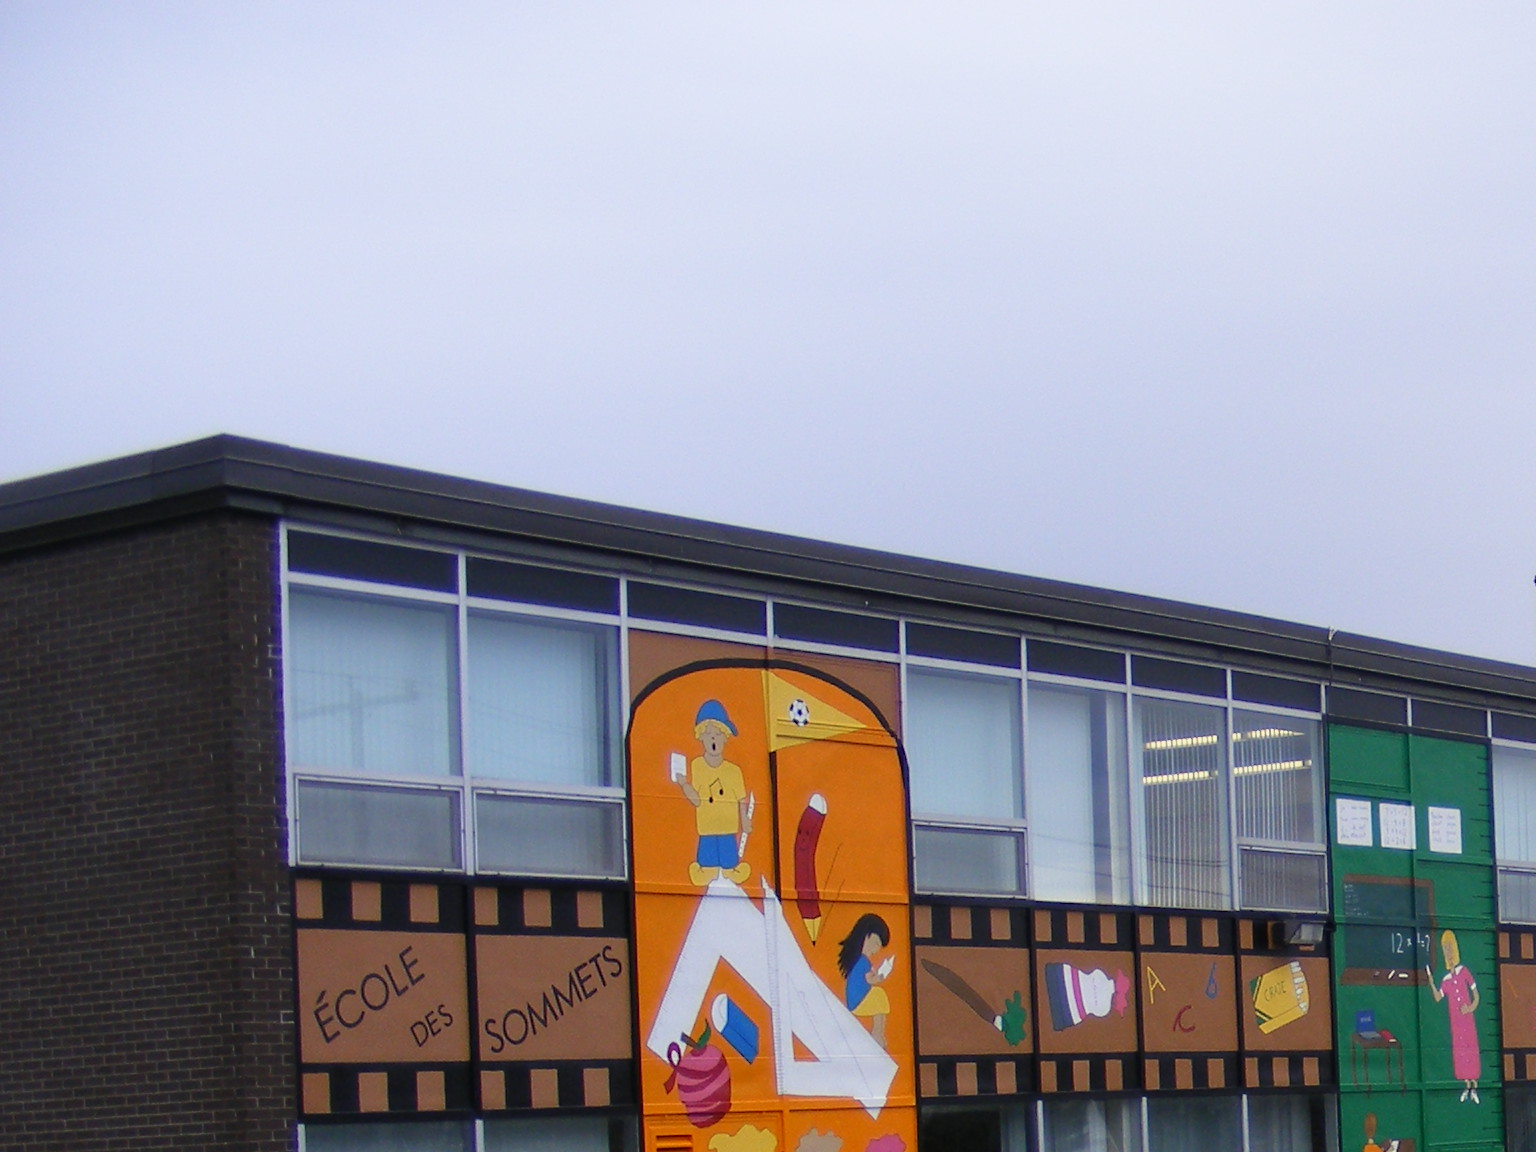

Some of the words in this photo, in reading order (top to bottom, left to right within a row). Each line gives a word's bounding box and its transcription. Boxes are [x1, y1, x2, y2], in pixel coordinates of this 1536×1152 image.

[312, 945, 426, 1044] ÉCOLE
[409, 1003, 454, 1048] DES
[484, 944, 623, 1053] SOMMETS
